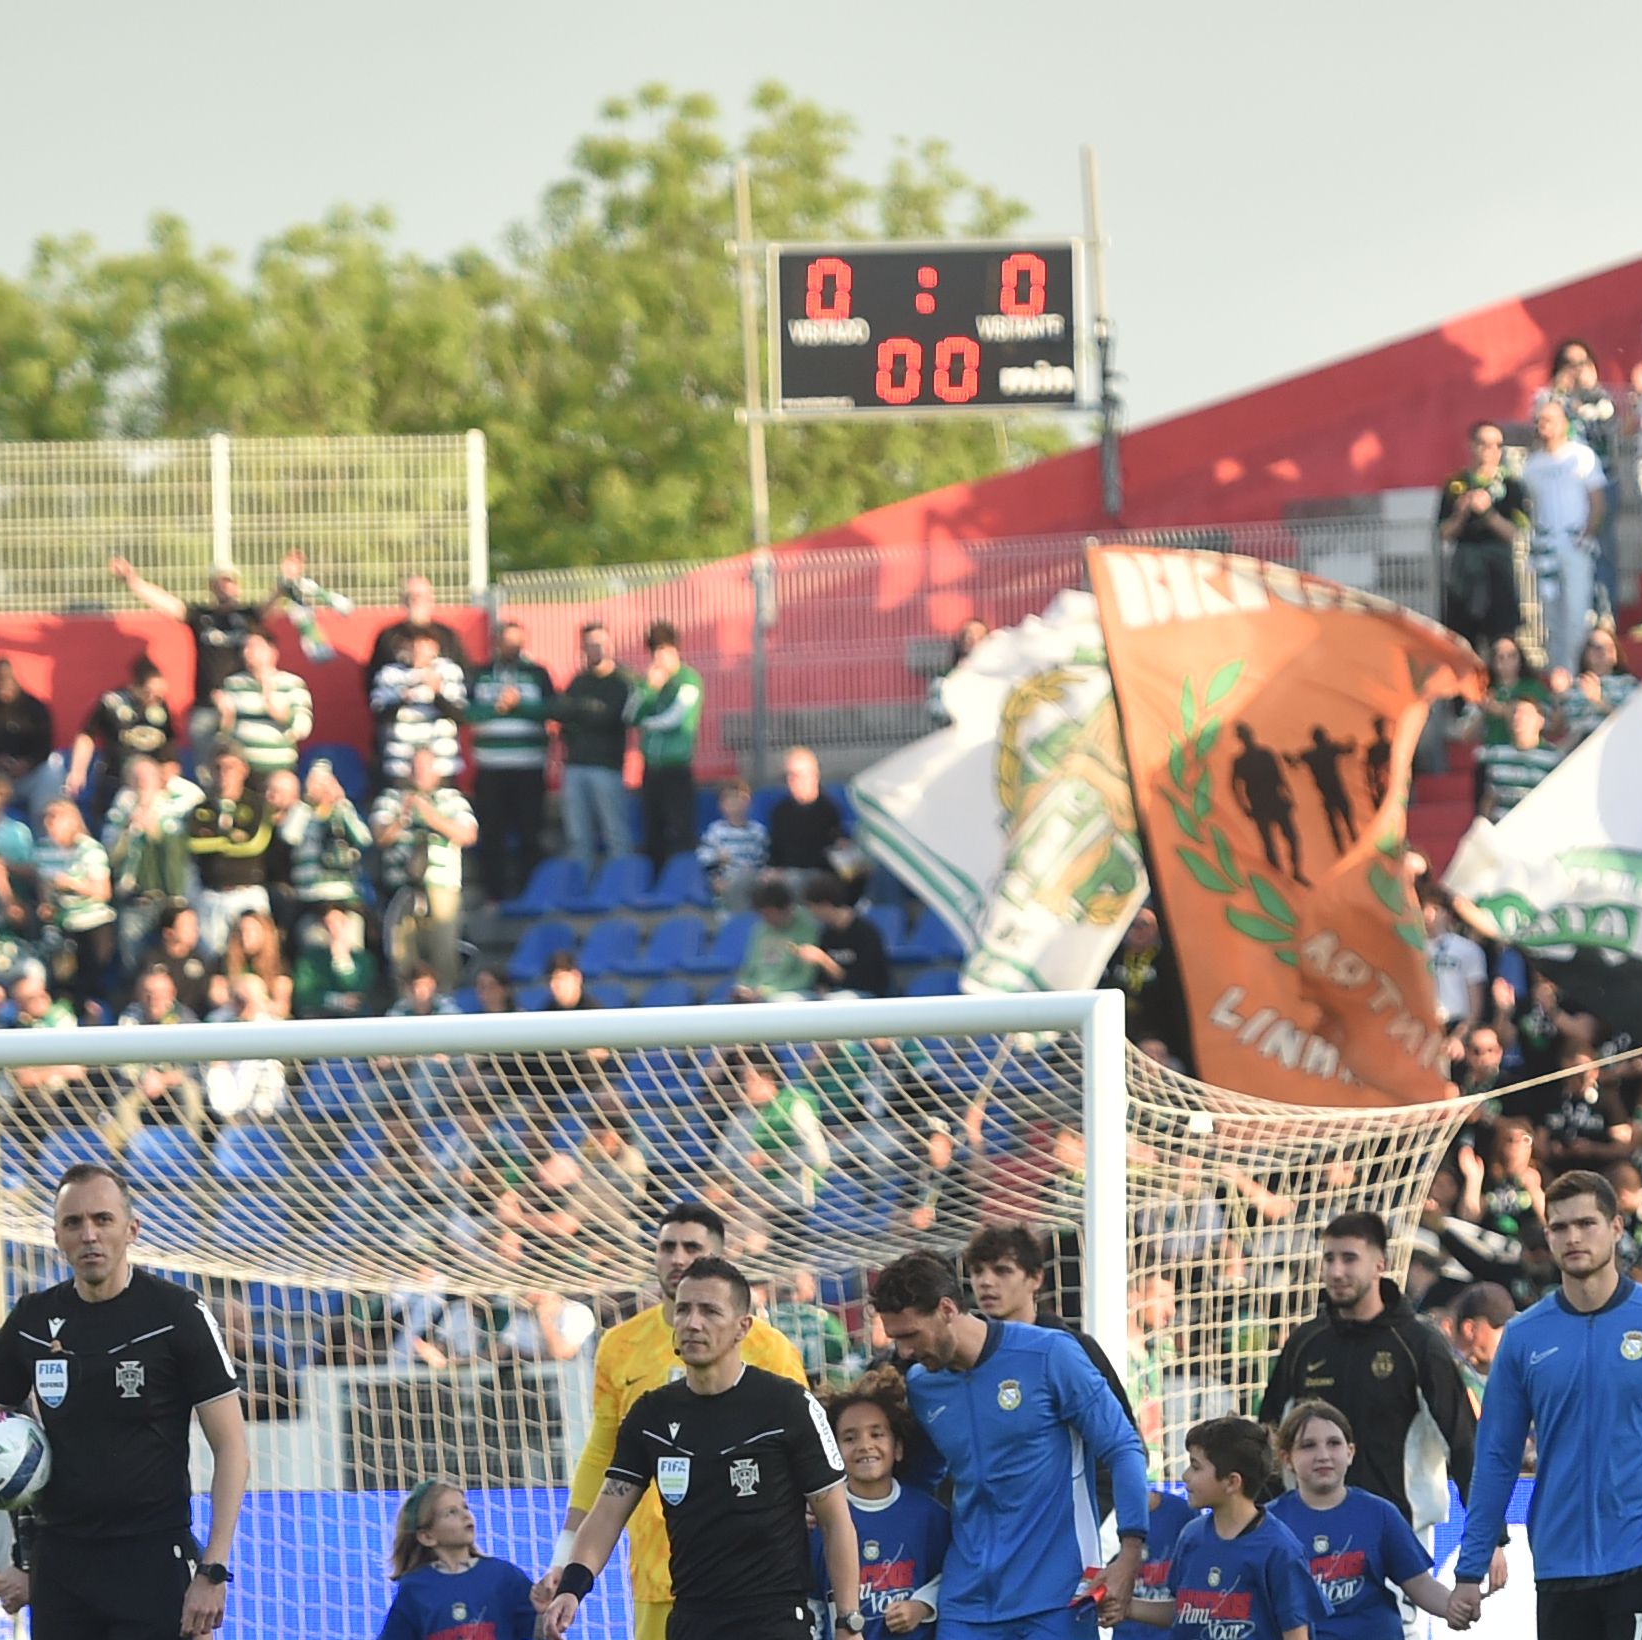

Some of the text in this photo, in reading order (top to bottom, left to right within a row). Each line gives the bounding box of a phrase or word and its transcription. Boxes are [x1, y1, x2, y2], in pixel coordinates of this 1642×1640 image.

[805, 257, 852, 320] 0
[1000, 253, 1046, 316] 0
[876, 336, 980, 403] 00
[39, 1363, 64, 1374] FIFA
[660, 1461, 686, 1473] FIFA
[1207, 1619, 1246, 1640] Voar
